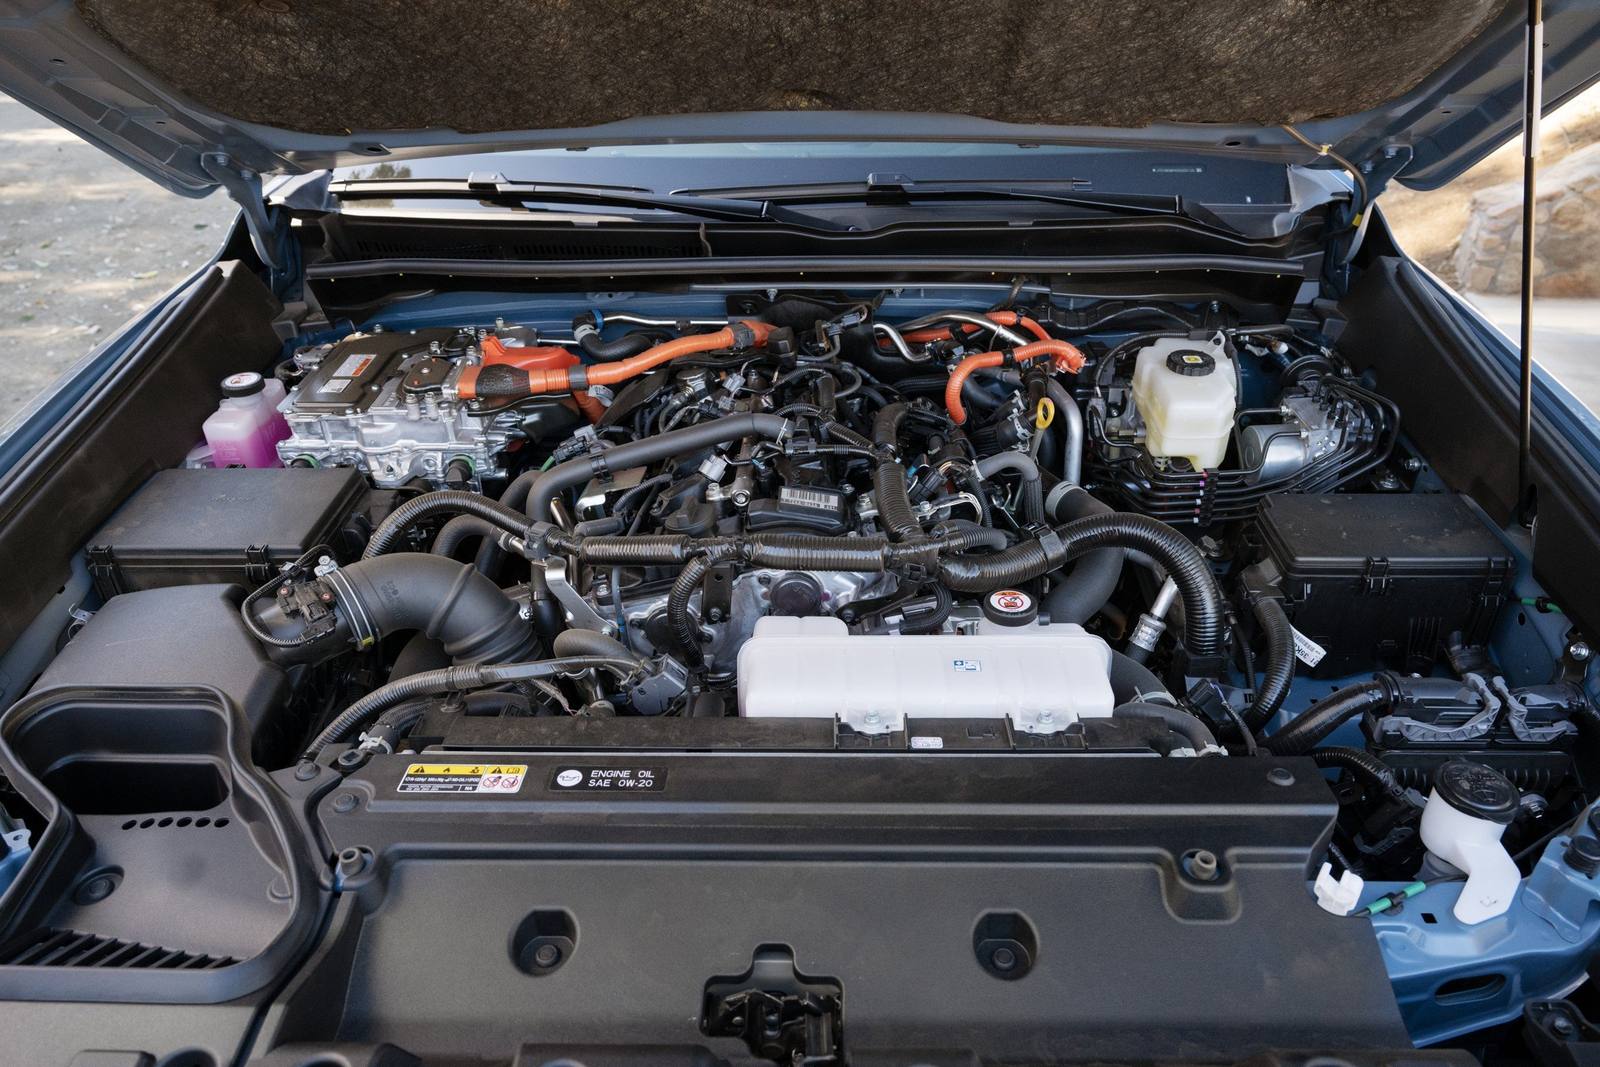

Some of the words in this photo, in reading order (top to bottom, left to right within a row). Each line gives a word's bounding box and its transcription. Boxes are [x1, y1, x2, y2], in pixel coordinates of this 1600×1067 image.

[590, 770, 632, 778] ENGINE
[638, 770, 655, 778] OIL
[588, 779, 611, 787] SAE
[618, 779, 653, 787] 0W-20
